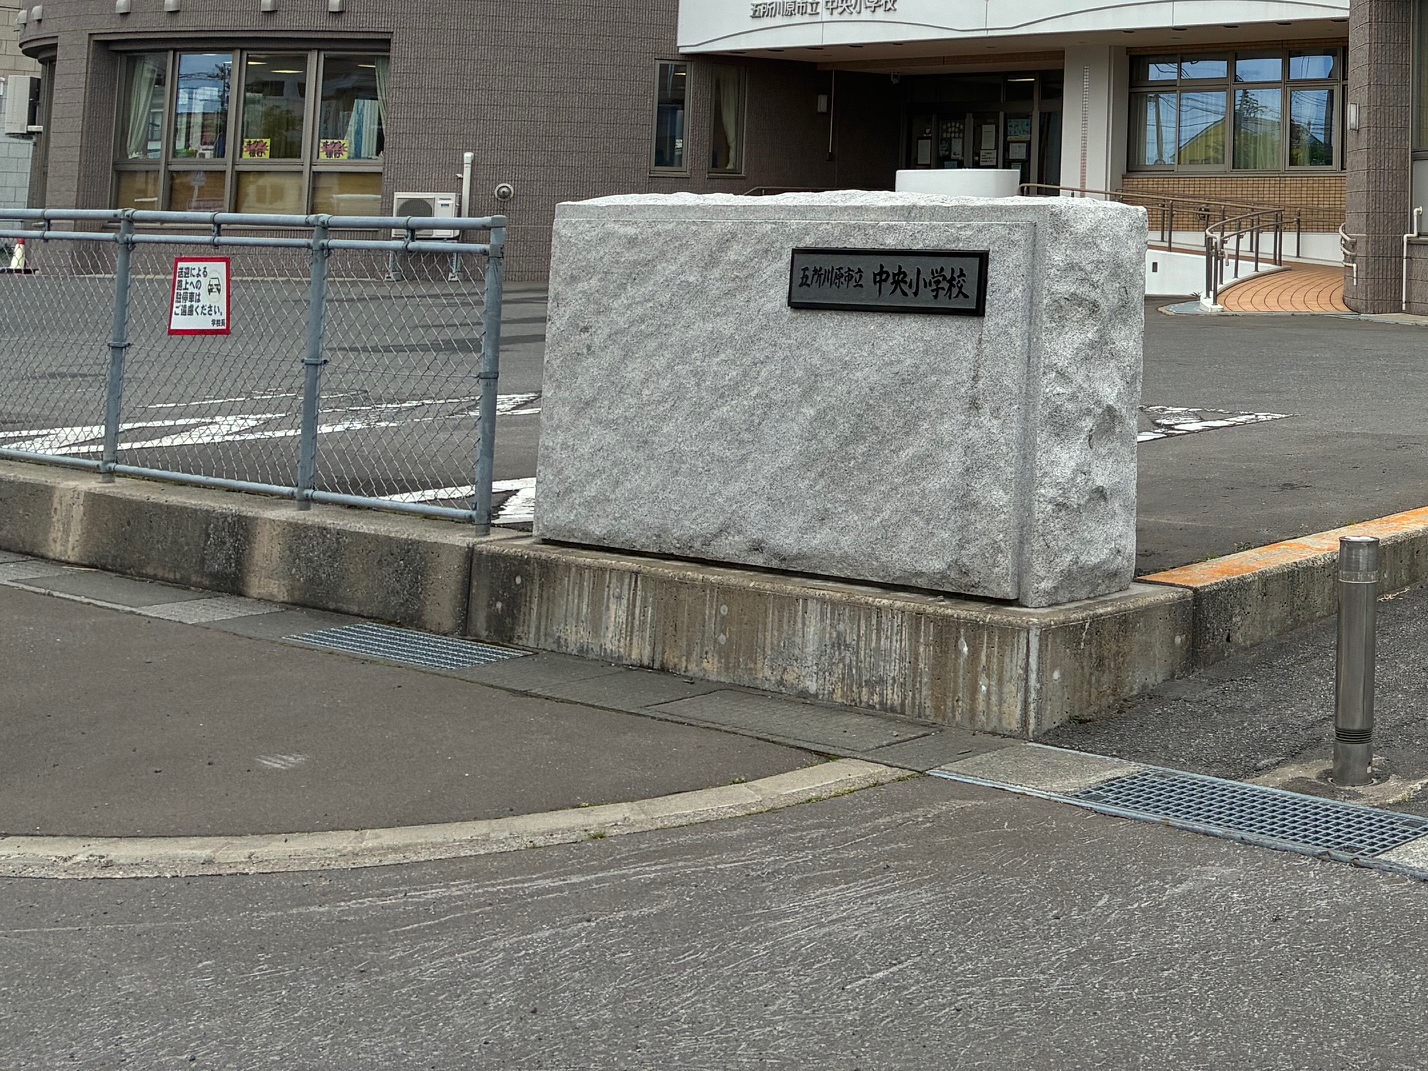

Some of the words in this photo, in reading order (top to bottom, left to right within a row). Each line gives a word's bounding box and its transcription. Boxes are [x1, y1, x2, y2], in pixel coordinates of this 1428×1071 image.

[750, 0, 820, 18] 五所川原市立
[177, 266, 208, 278] 送迎による
[176, 279, 202, 290] 路上への
[798, 266, 864, 289] 五所川原市立
[872, 263, 970, 300] 中央小学校
[175, 291, 201, 303] 駐停車は
